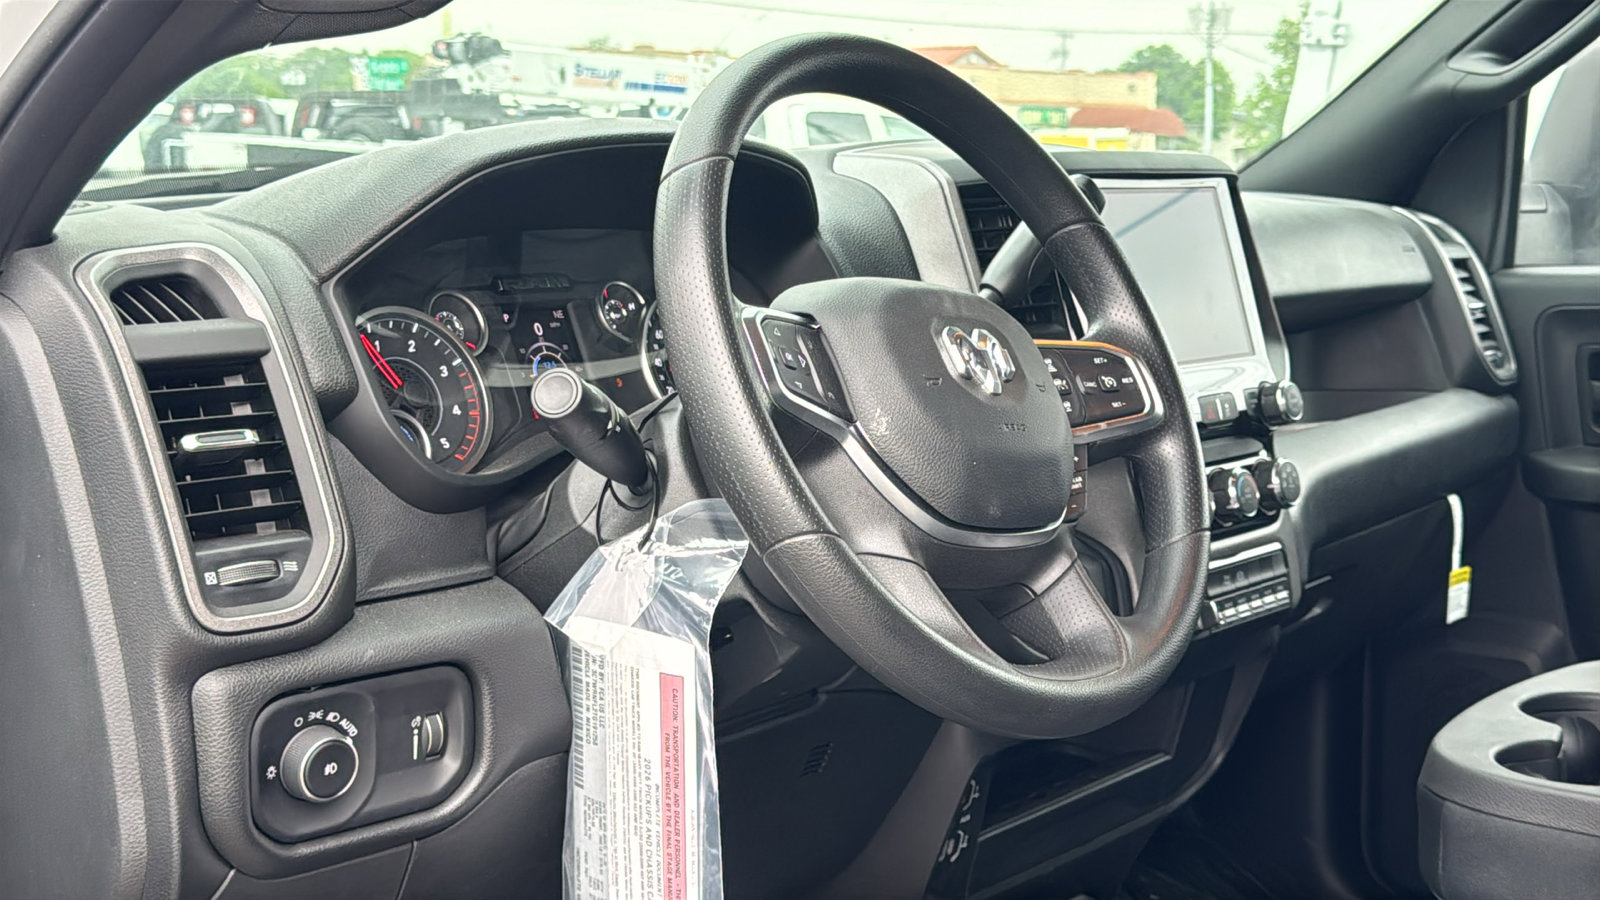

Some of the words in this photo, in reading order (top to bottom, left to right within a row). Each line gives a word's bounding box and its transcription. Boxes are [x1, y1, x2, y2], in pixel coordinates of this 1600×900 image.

[408, 340, 417, 353] 2
[439, 365, 449, 378] 3
[452, 404, 462, 416] 4
[440, 437, 450, 450] 5
[339, 718, 358, 737] AUTO
[672, 725, 680, 790] TRANSPORTATION
[645, 783, 653, 825] PICKUPS
[665, 803, 672, 814] BY
[645, 826, 653, 847] AND
[646, 848, 654, 889] CHASSIS
